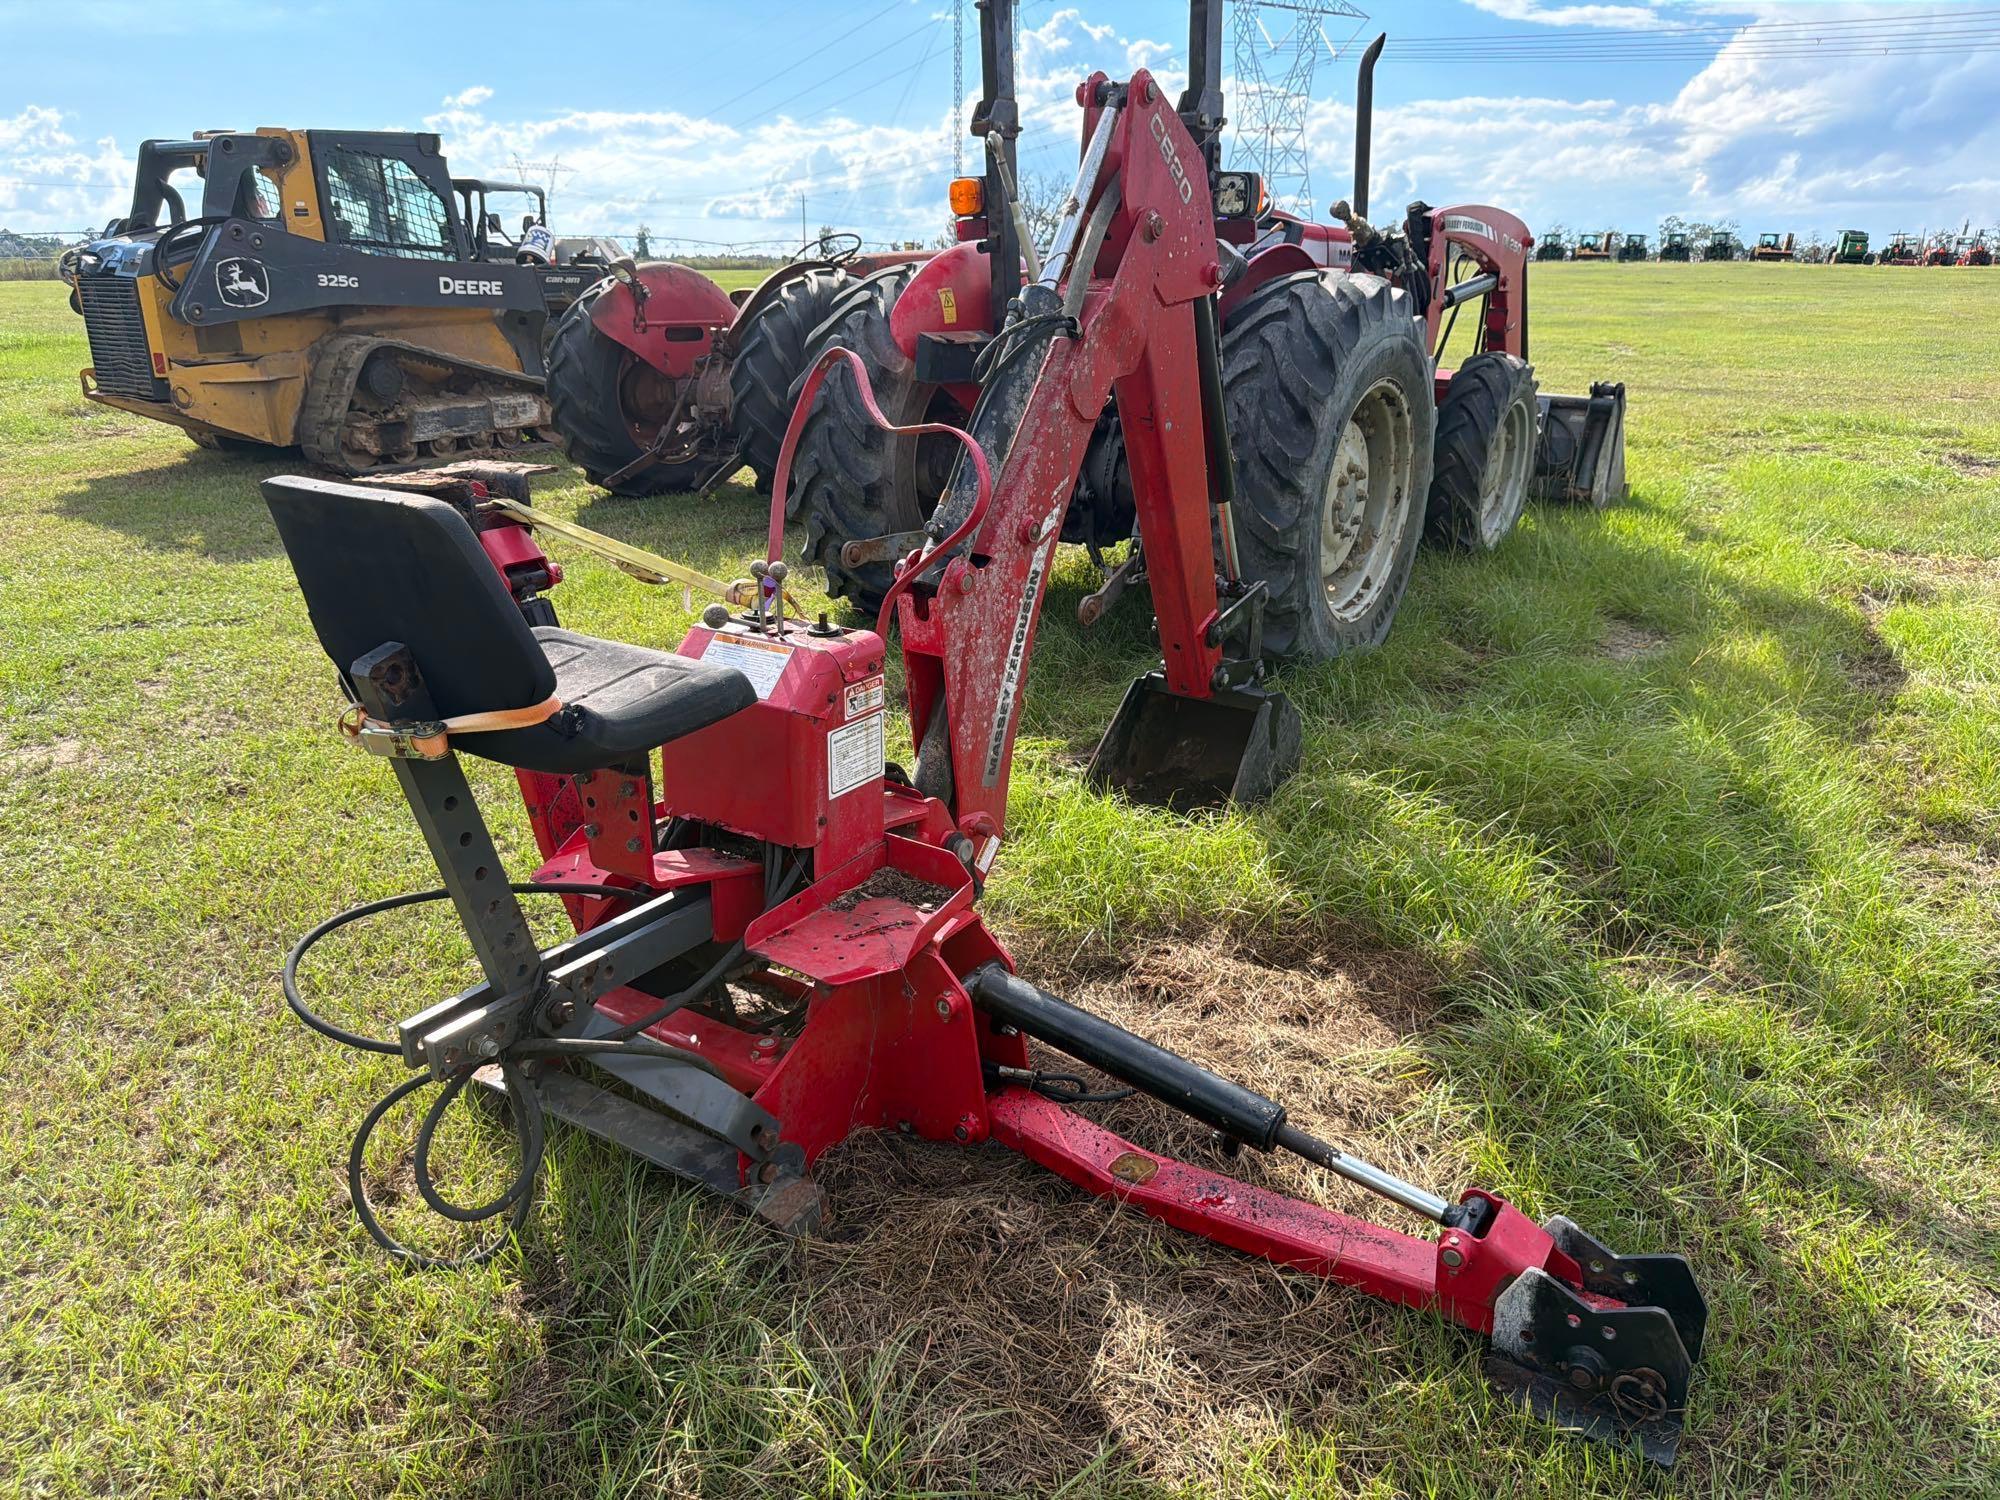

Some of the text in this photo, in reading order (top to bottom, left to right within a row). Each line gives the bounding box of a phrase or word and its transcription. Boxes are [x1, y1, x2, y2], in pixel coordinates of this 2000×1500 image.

[1150, 112, 1193, 205] CB20
[317, 274, 360, 288] 325G
[438, 276, 504, 296] DEERE
[545, 276, 581, 284] can-am
[741, 640, 770, 650] WARNING
[987, 569, 1040, 776] MASSEY FERGUSON
[855, 679, 880, 694] DANGER
